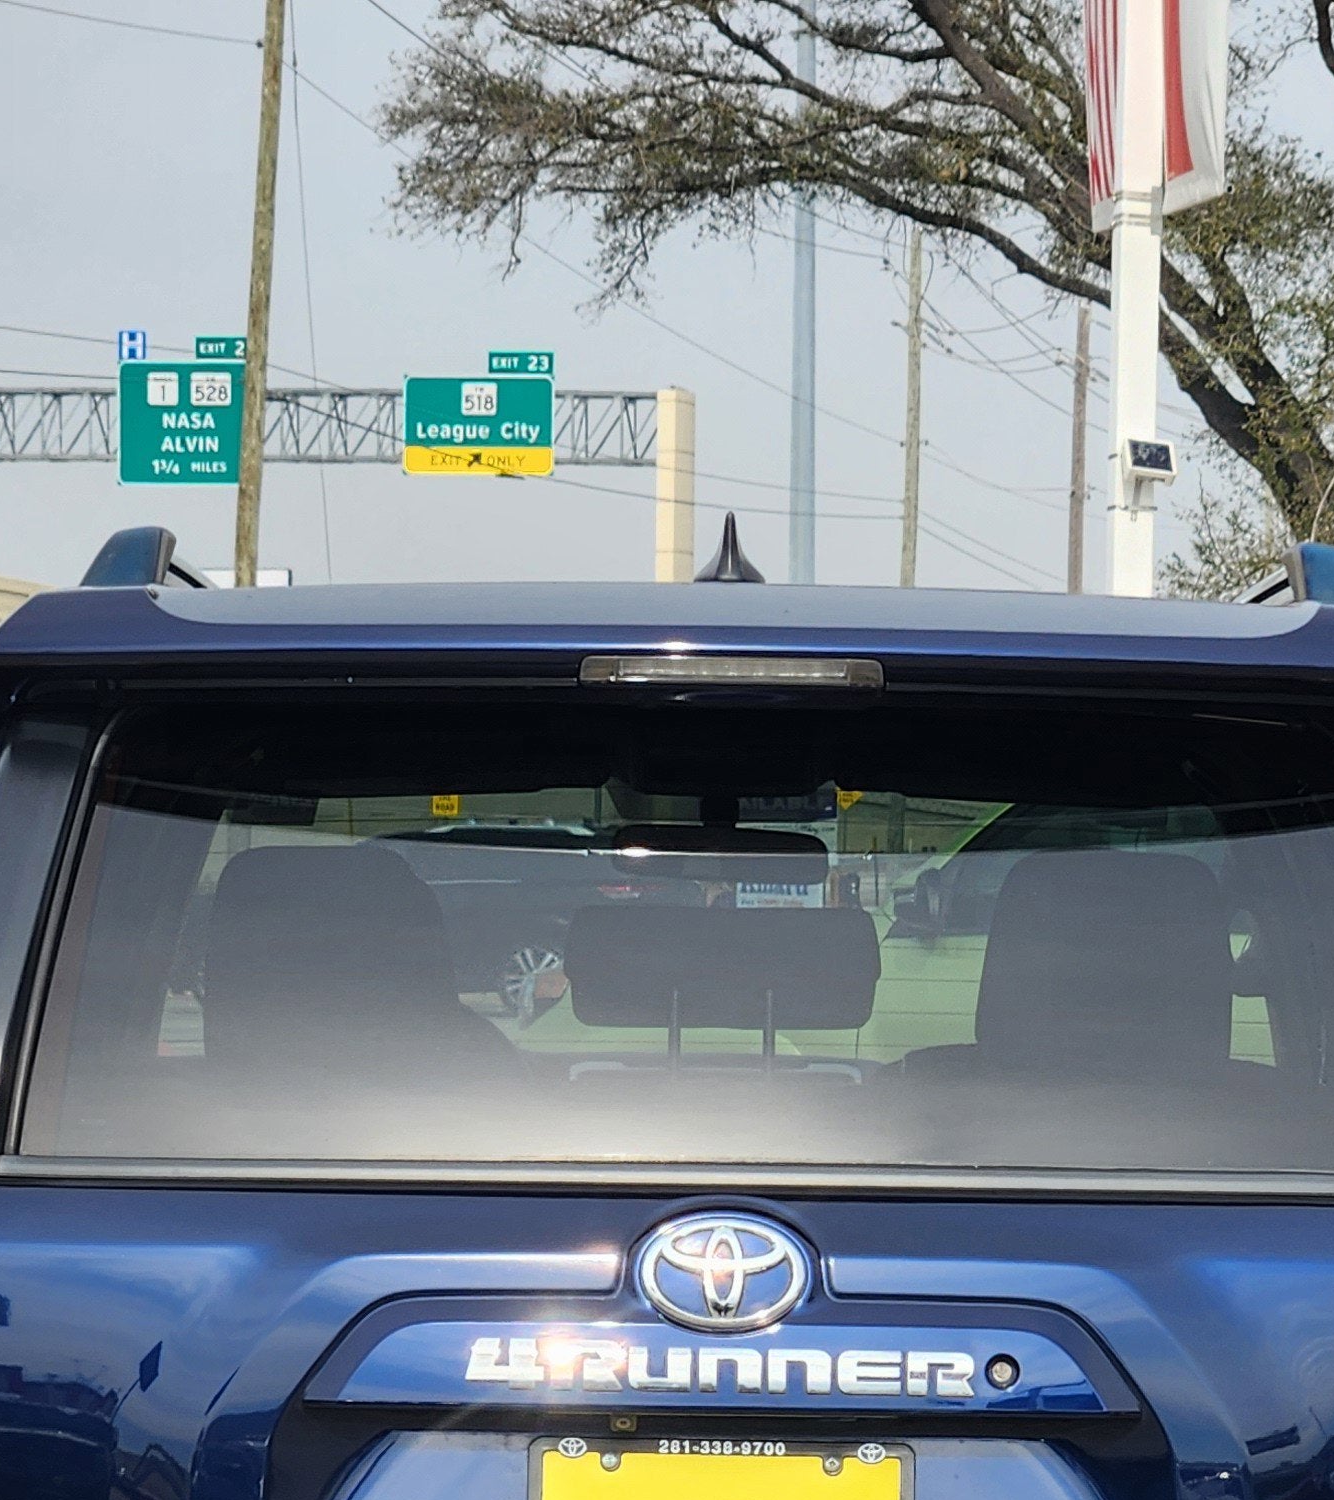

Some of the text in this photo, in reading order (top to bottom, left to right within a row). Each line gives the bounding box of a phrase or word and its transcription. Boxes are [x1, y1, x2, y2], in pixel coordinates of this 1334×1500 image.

[199, 341, 246, 356] EXIT 2
[491, 355, 549, 372] EXIT 23
[195, 385, 228, 401] 528
[464, 395, 494, 410] 518
[162, 412, 215, 429] NASA
[416, 421, 540, 443] League City
[160, 436, 219, 452] ALVIN
[190, 461, 227, 473] MILES
[431, 455, 526, 467] EXIT ONLY
[658, 1439, 786, 1456] 281-338-9700
